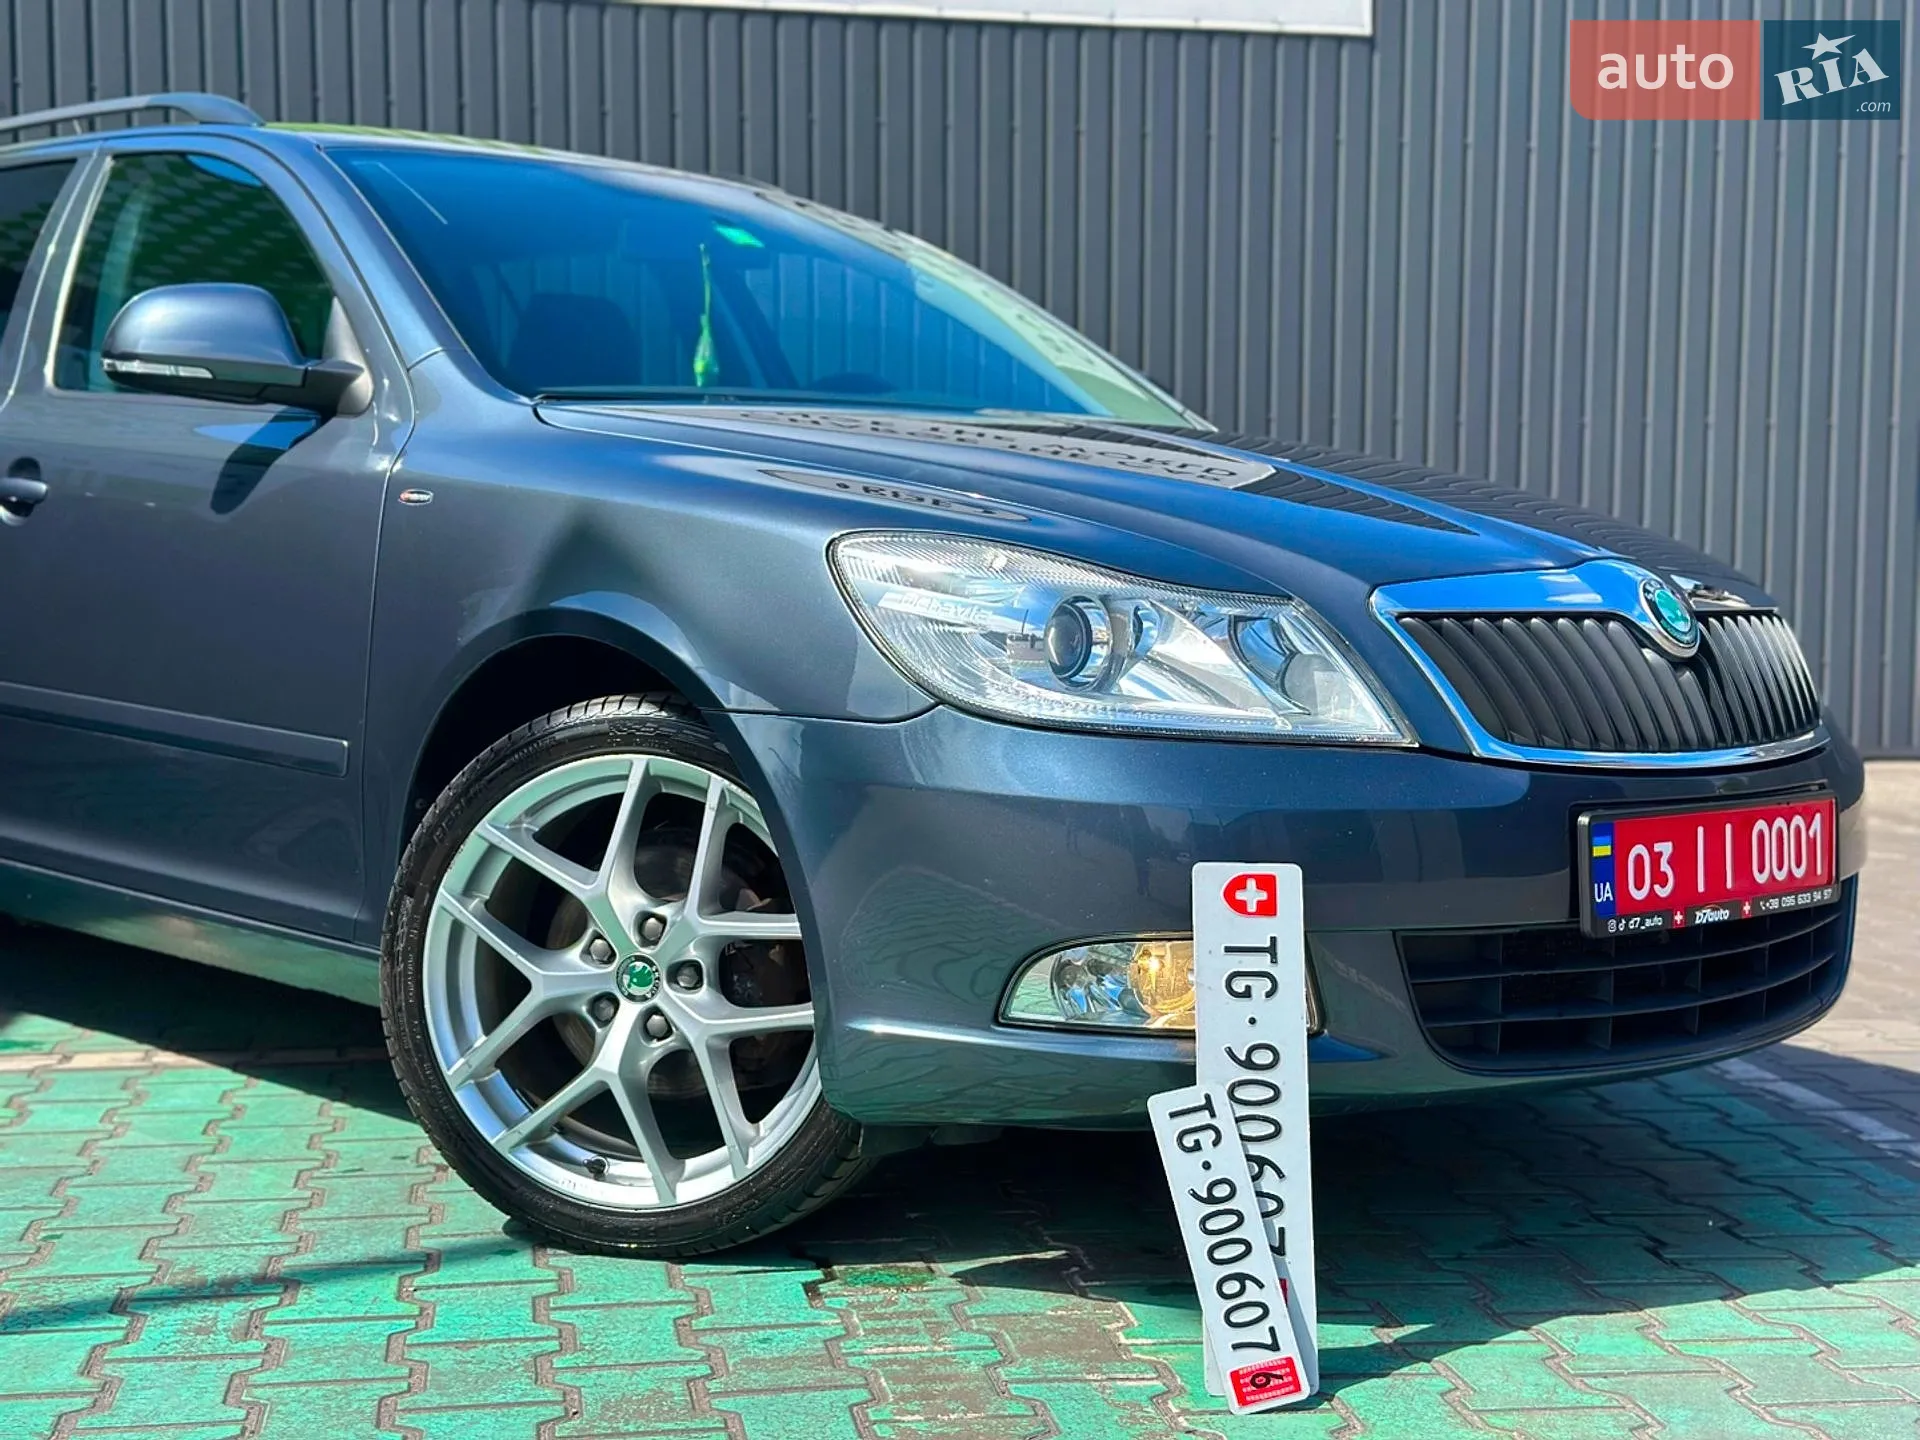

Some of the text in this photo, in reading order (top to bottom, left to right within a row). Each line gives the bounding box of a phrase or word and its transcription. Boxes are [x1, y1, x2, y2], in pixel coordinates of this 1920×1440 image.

[1627, 841, 1676, 901] 03
[1751, 812, 1822, 884] 0001
[1594, 882, 1614, 903] UA
[1249, 1371, 1285, 1390] 6
